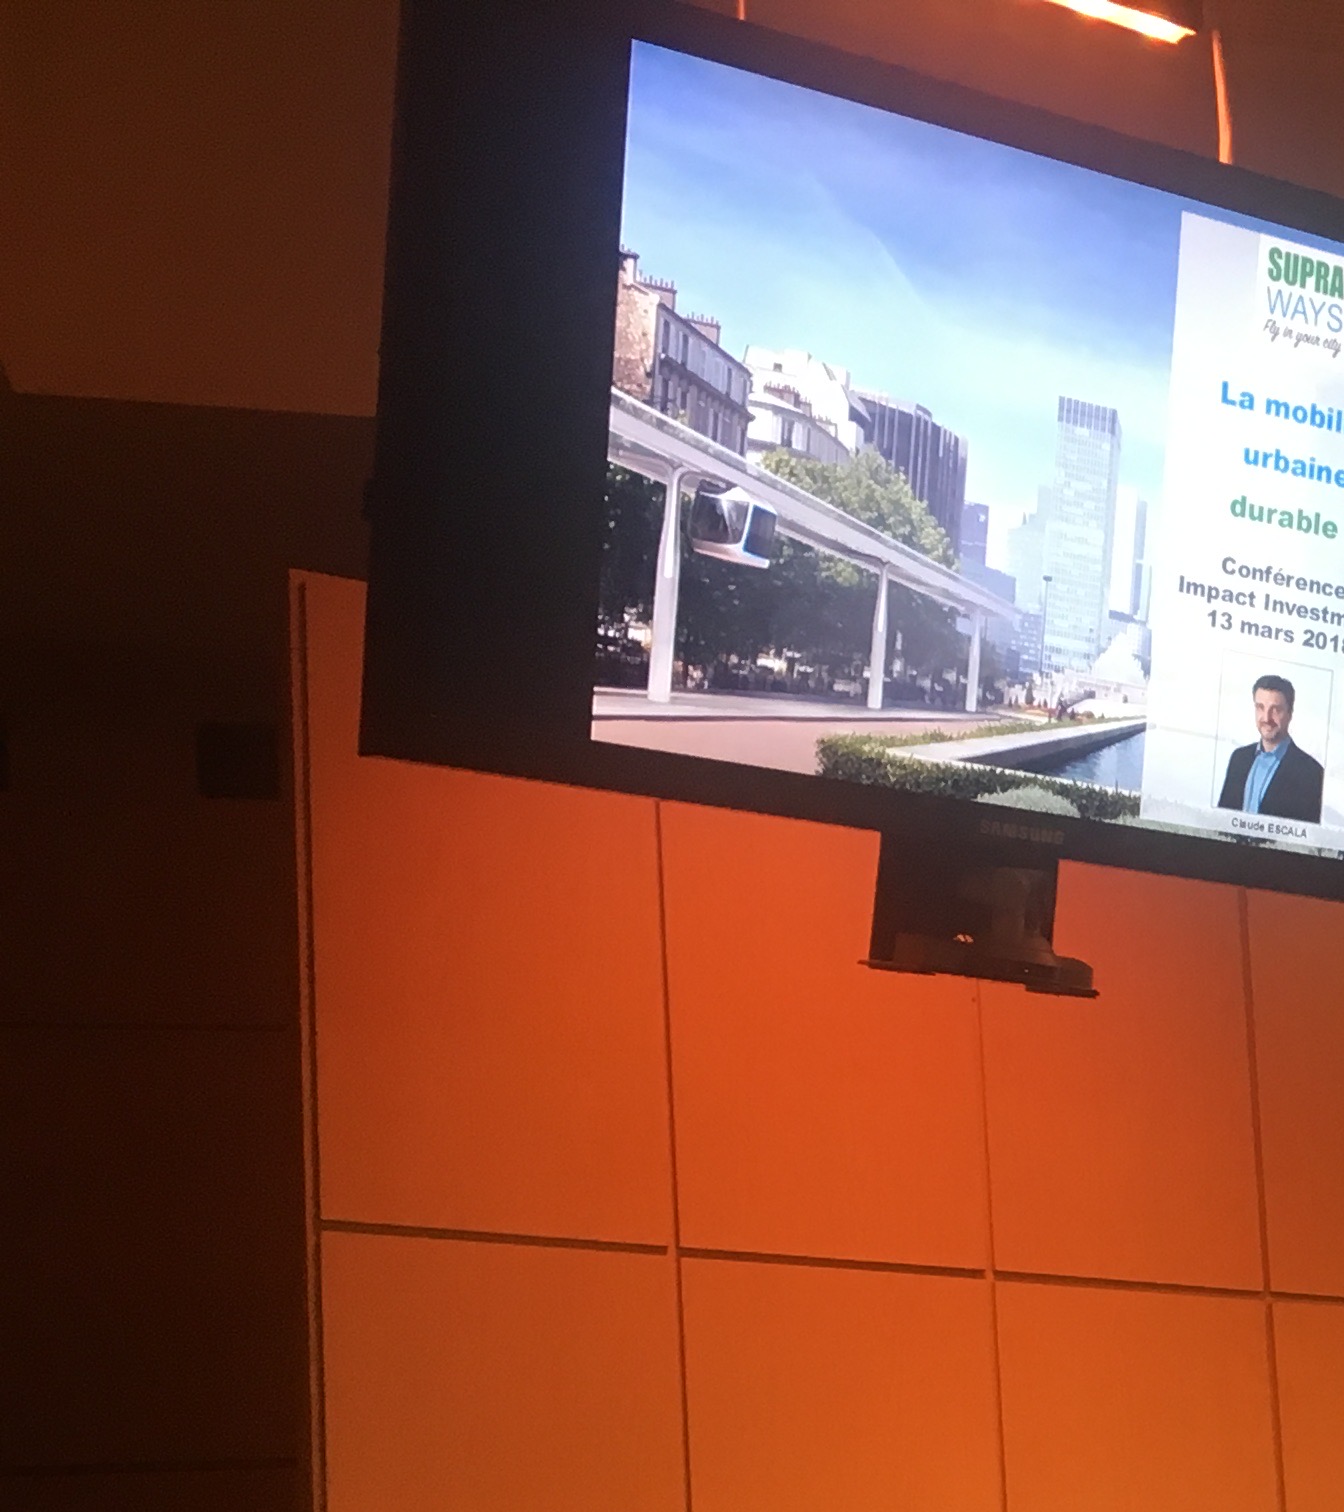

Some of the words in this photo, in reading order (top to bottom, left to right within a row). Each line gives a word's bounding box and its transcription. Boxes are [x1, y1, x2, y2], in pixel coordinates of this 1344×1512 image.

[1267, 247, 1344, 300] SUPRA
[1266, 286, 1343, 333] WAYS
[1263, 318, 1280, 342] Fly
[1283, 326, 1294, 341] in
[1294, 330, 1321, 349] your
[1322, 335, 1342, 358] city
[1220, 381, 1255, 411] La
[1229, 495, 1339, 540] durable
[1178, 575, 1257, 609] Impact
[1206, 609, 1233, 631] 13
[1240, 620, 1295, 644] mars
[979, 819, 1065, 845] SAMSUNG
[1231, 817, 1265, 833] Claude
[1267, 823, 1308, 839] ESCALA
